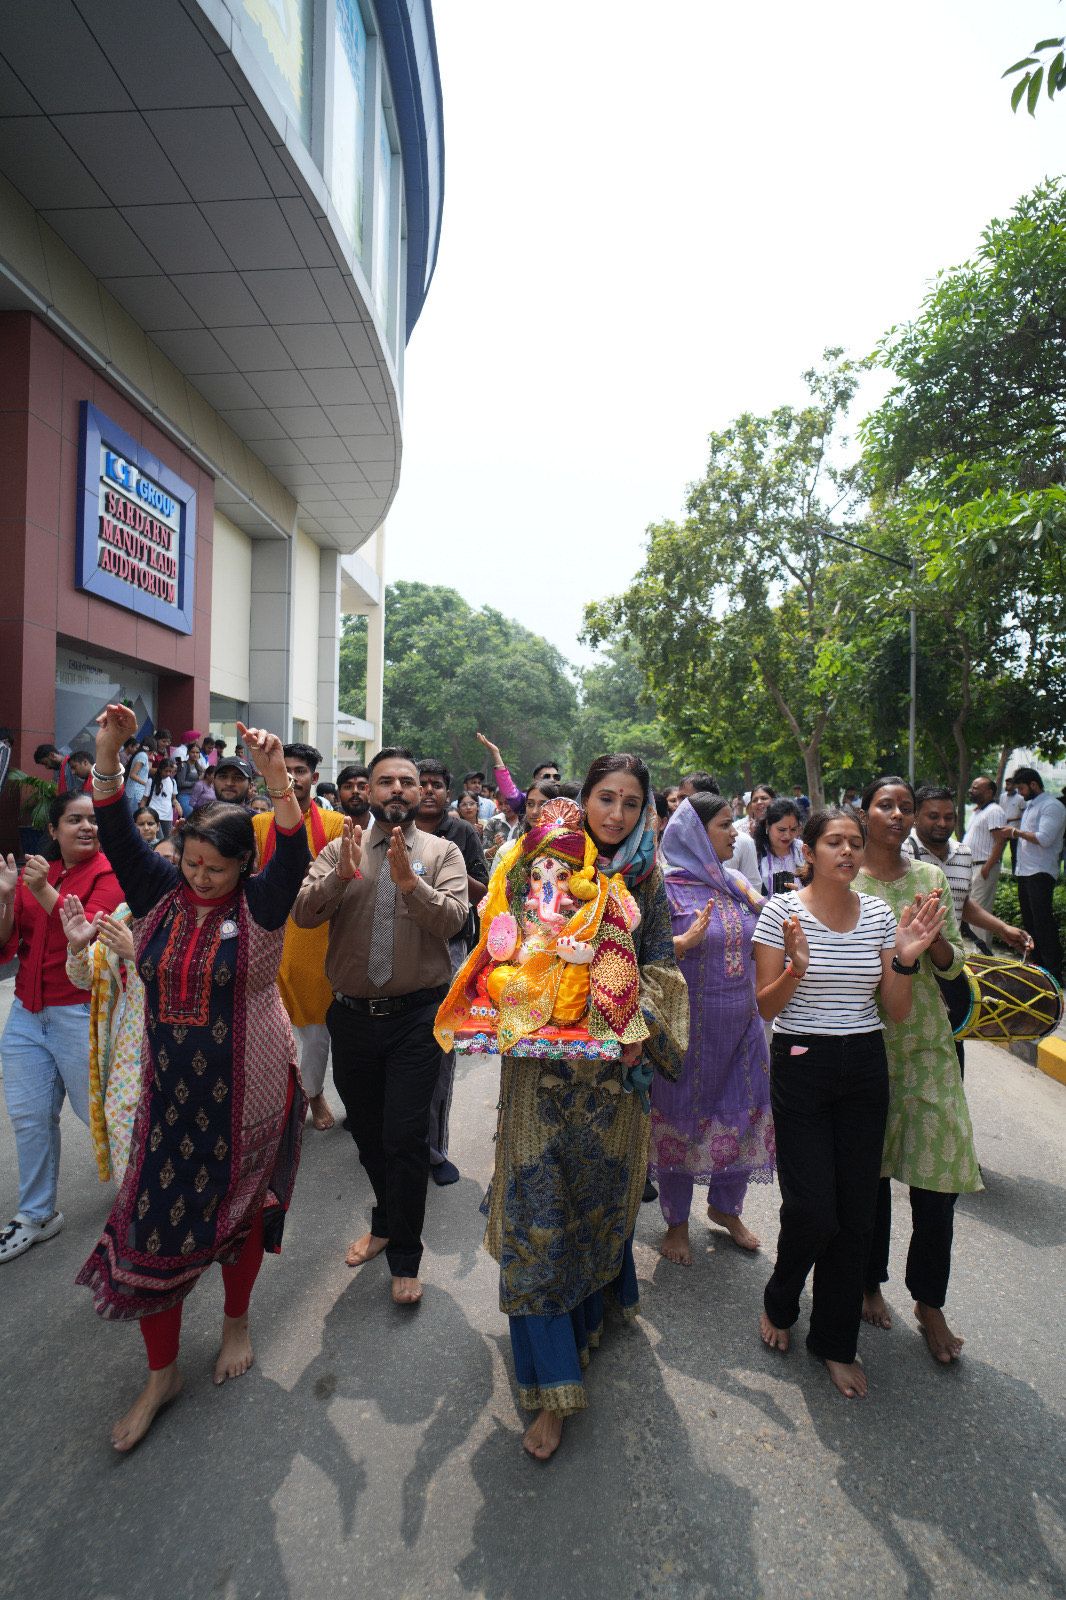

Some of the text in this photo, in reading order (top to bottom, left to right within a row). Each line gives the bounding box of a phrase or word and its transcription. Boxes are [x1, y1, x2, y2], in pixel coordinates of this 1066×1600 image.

[107, 491, 174, 551] SARDARNI
[137, 478, 176, 518] GROUP
[100, 546, 176, 604] AUDITORIUM
[101, 515, 177, 579] MANJIT KAUR
